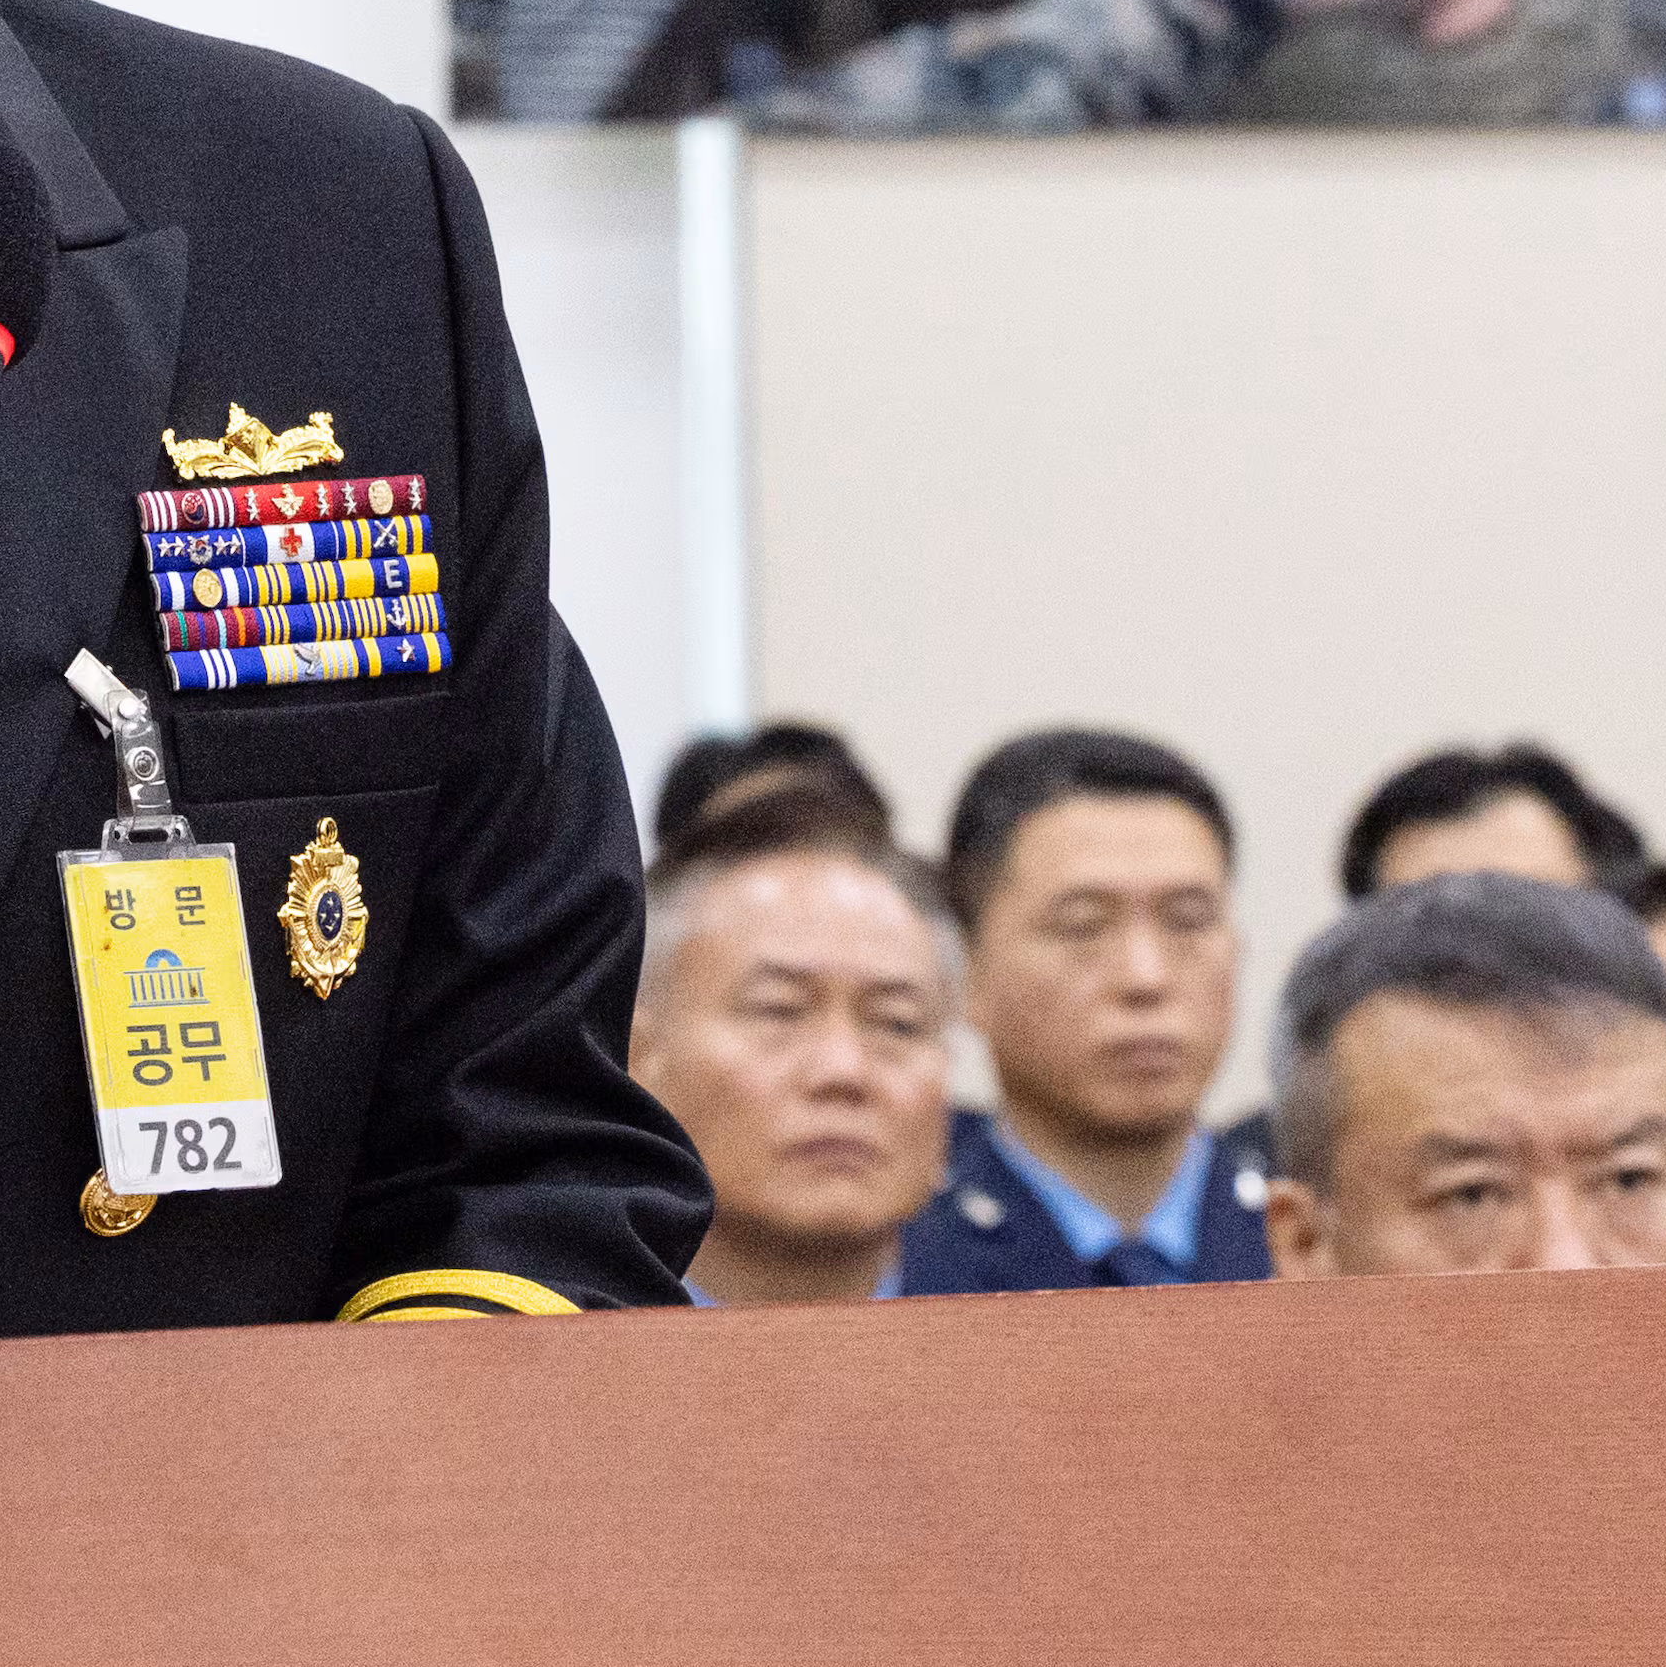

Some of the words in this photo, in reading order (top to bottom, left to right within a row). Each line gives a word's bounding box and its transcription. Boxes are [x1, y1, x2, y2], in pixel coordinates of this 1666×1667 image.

[384, 559, 403, 589] E
[126, 1020, 227, 1086] 공무
[139, 1117, 242, 1175] 782
